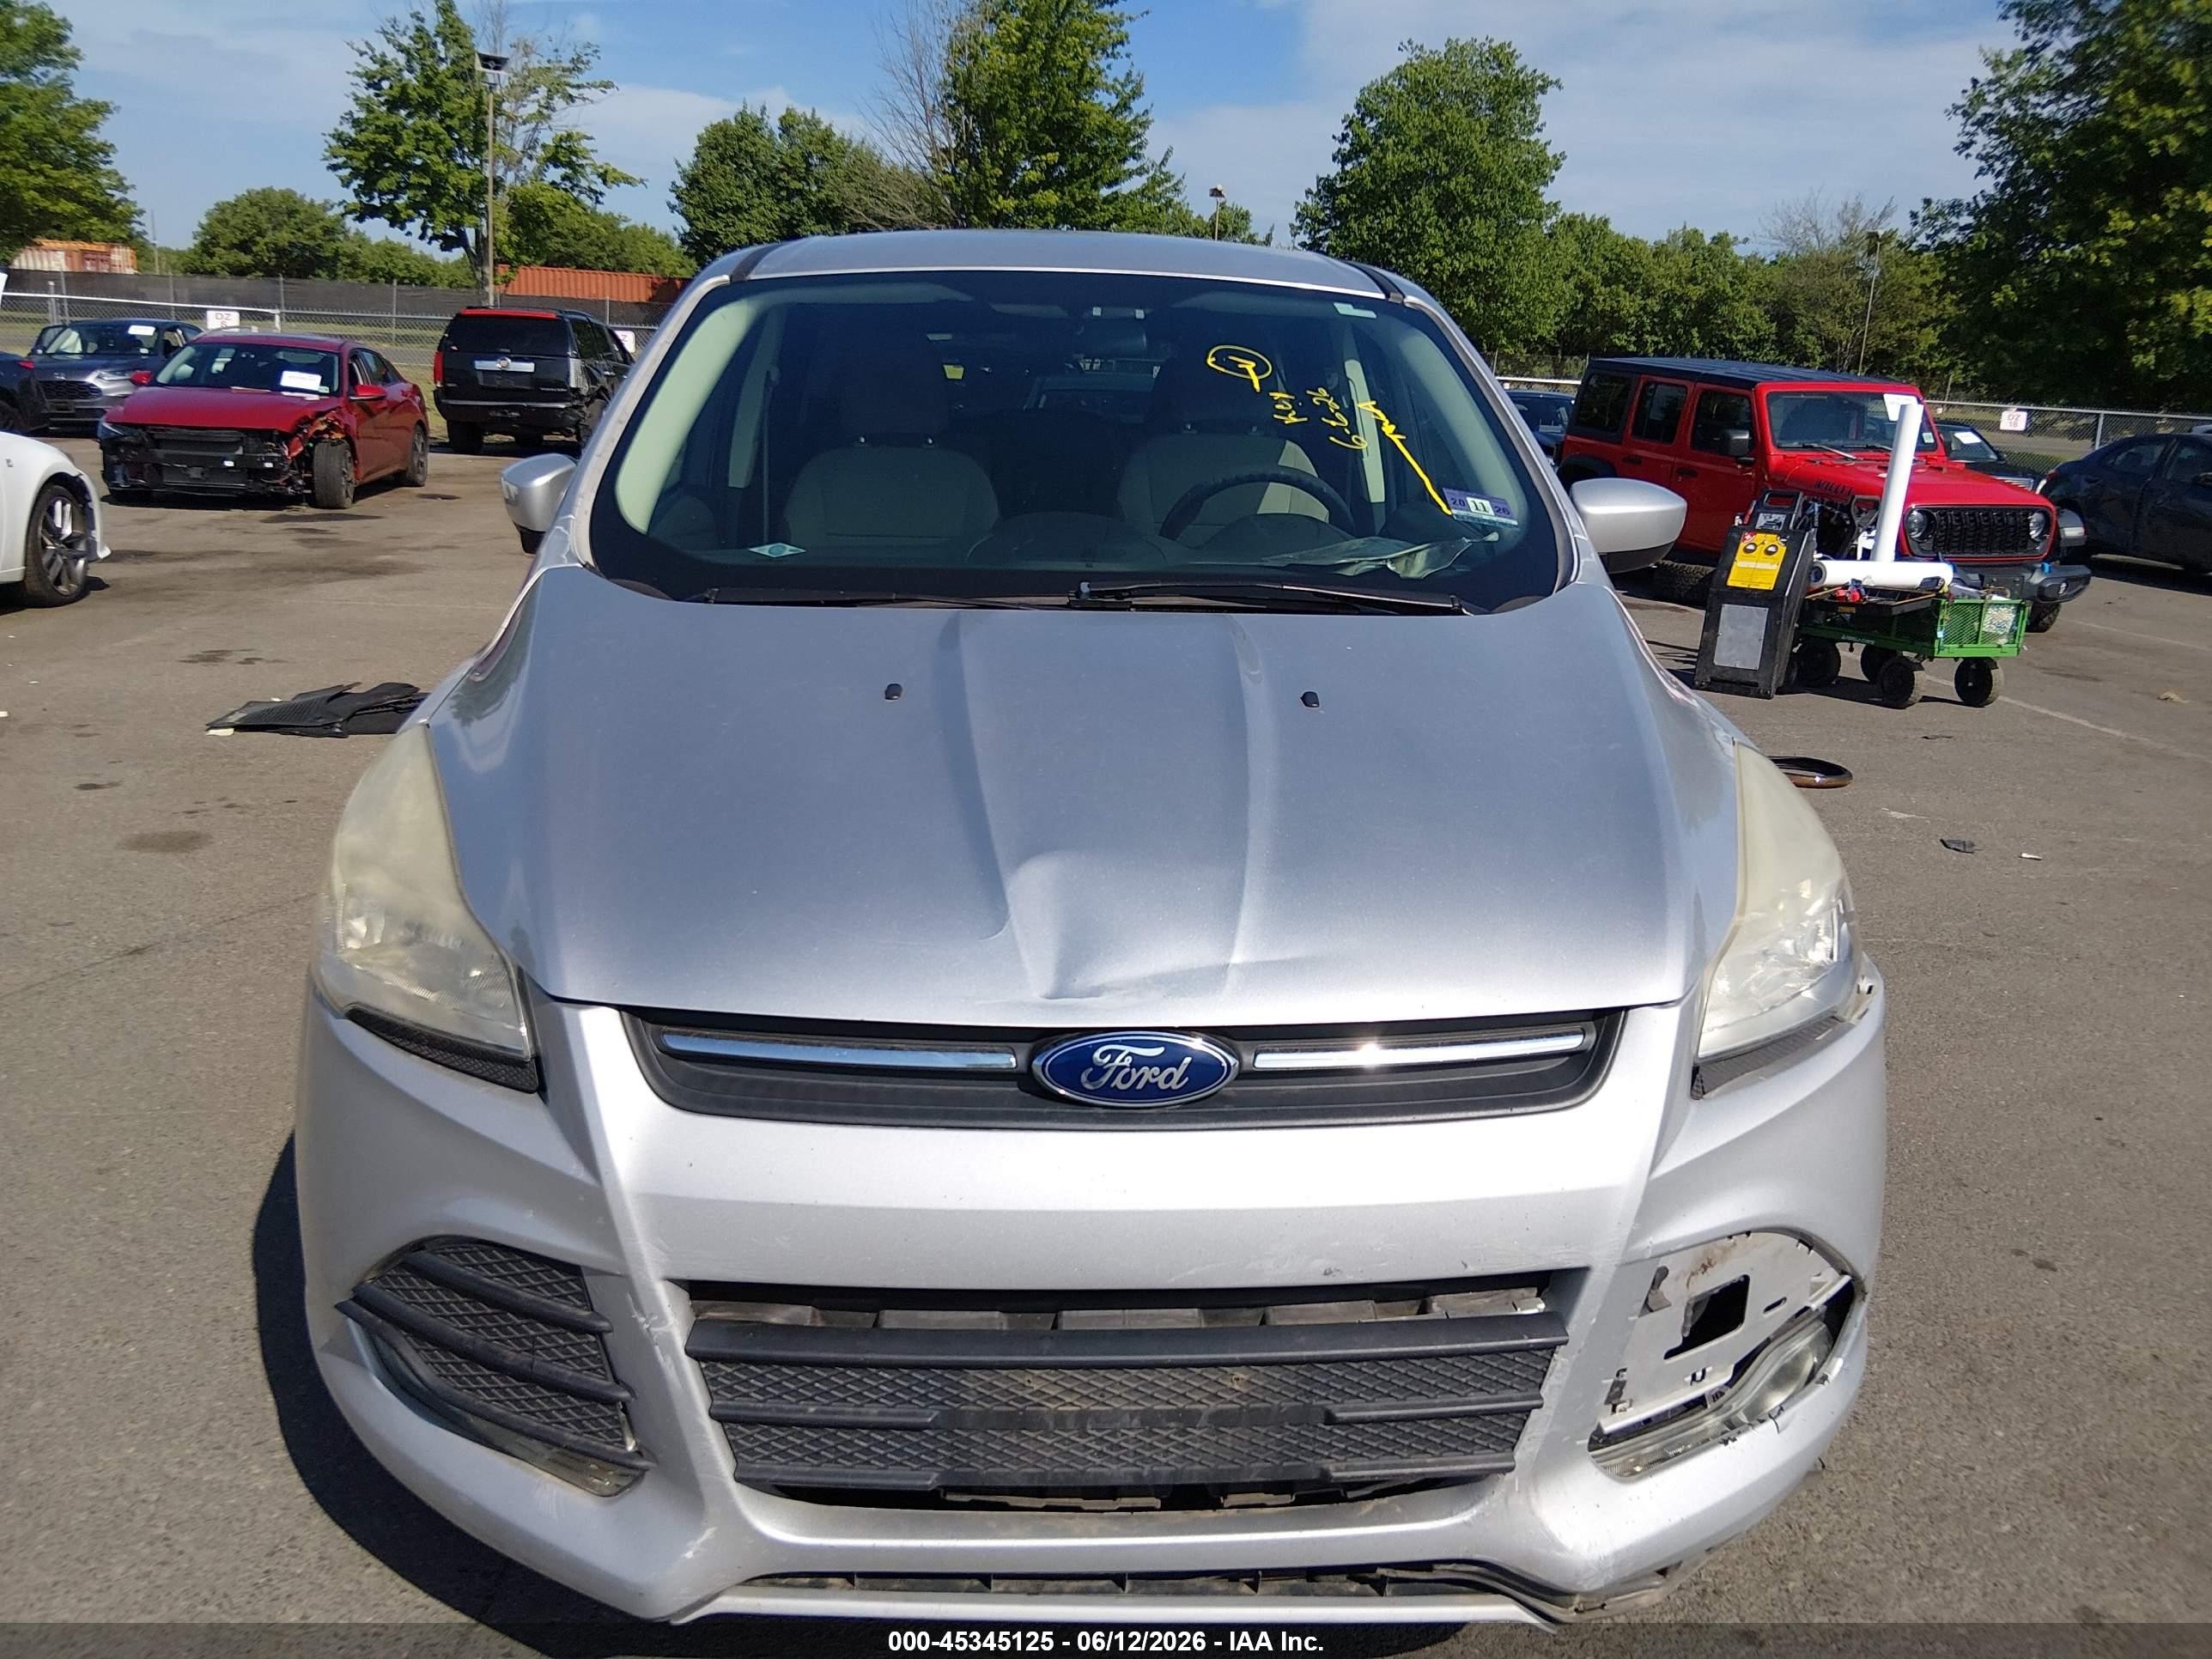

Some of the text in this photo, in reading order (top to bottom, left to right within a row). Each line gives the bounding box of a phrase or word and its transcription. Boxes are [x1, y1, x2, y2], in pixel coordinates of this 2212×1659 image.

[1306, 386, 1368, 450] 6-6-26
[1450, 497, 1466, 507] 20
[1470, 500, 1490, 514] 11
[1080, 1044, 1192, 1091] Ford
